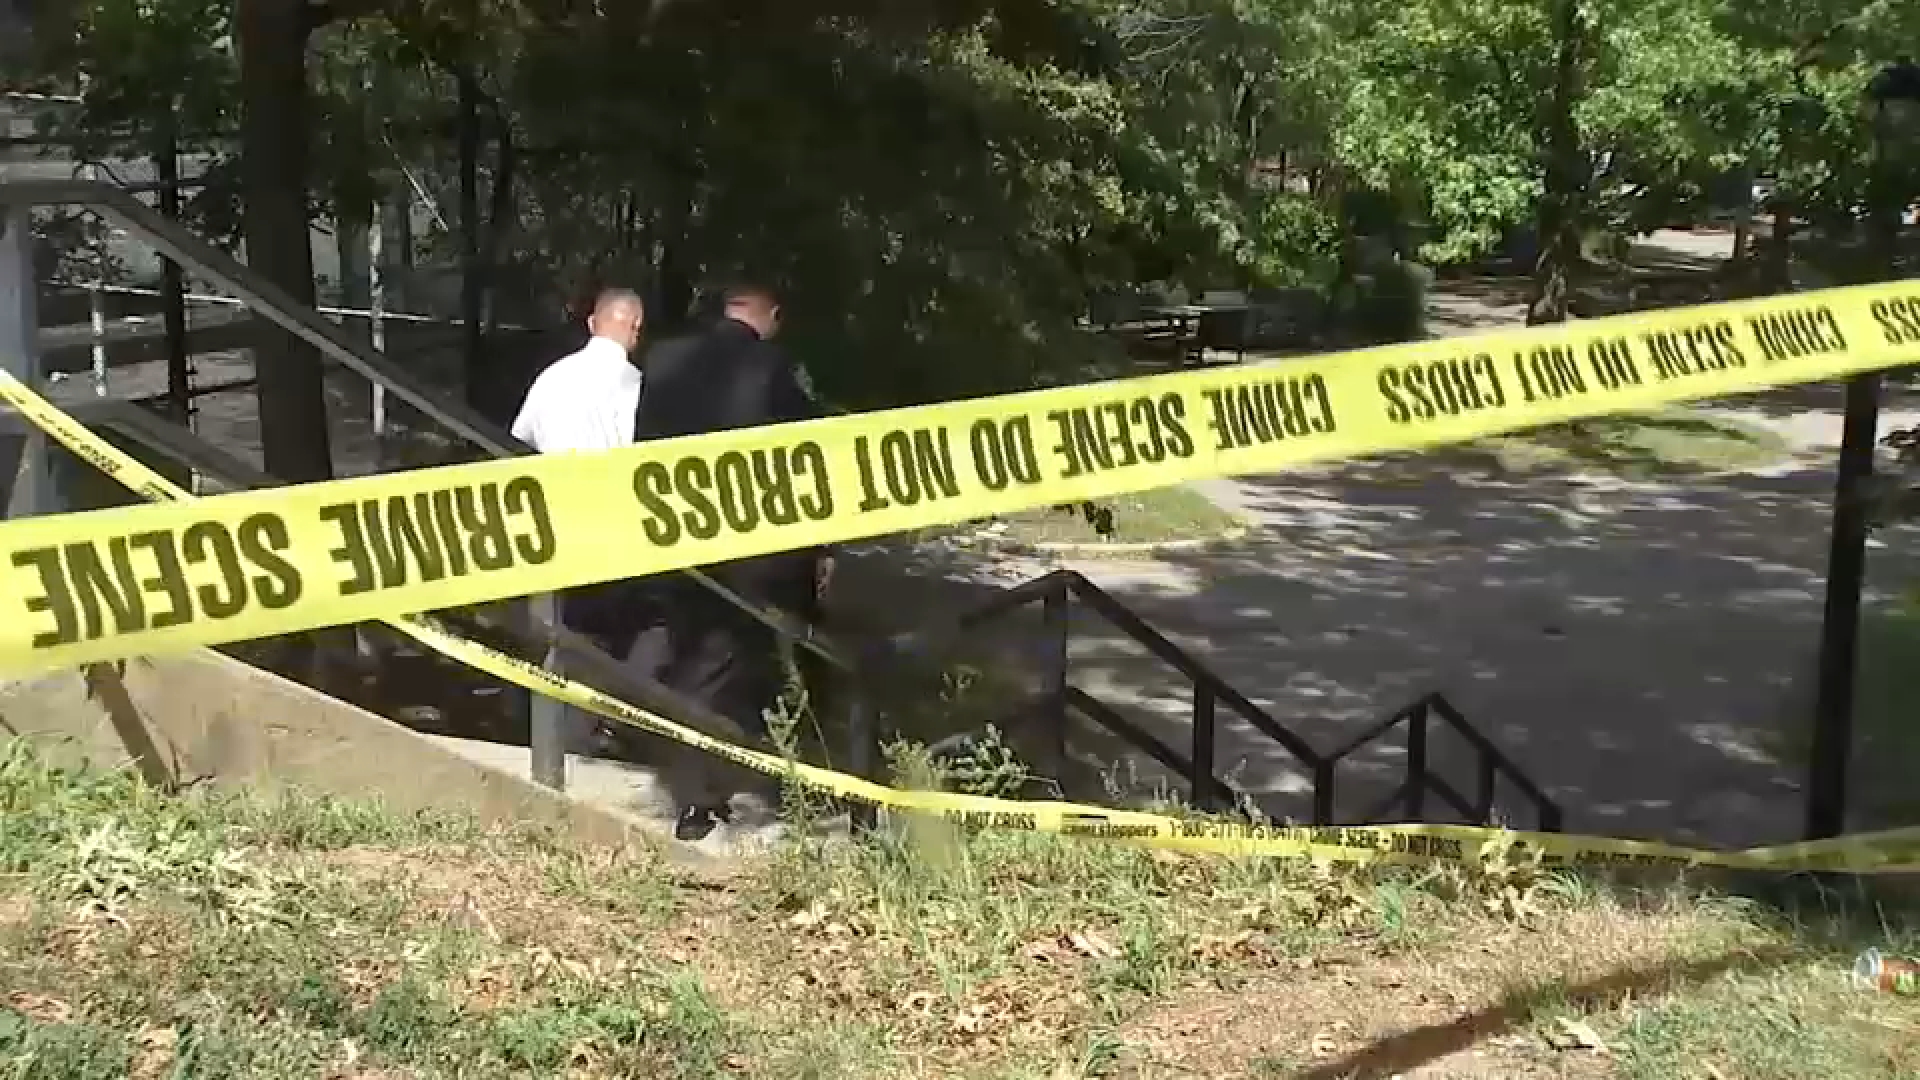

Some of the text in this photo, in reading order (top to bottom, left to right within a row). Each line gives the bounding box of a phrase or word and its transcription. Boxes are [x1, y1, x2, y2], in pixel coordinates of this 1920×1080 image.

[1378, 306, 1846, 424] CRIME SCENE DO NOT CROSS
[1870, 296, 1920, 344] OSS
[634, 372, 1336, 546] CRIME SCENE DO NOT CROSS
[10, 476, 556, 650] CRIME SCENE
